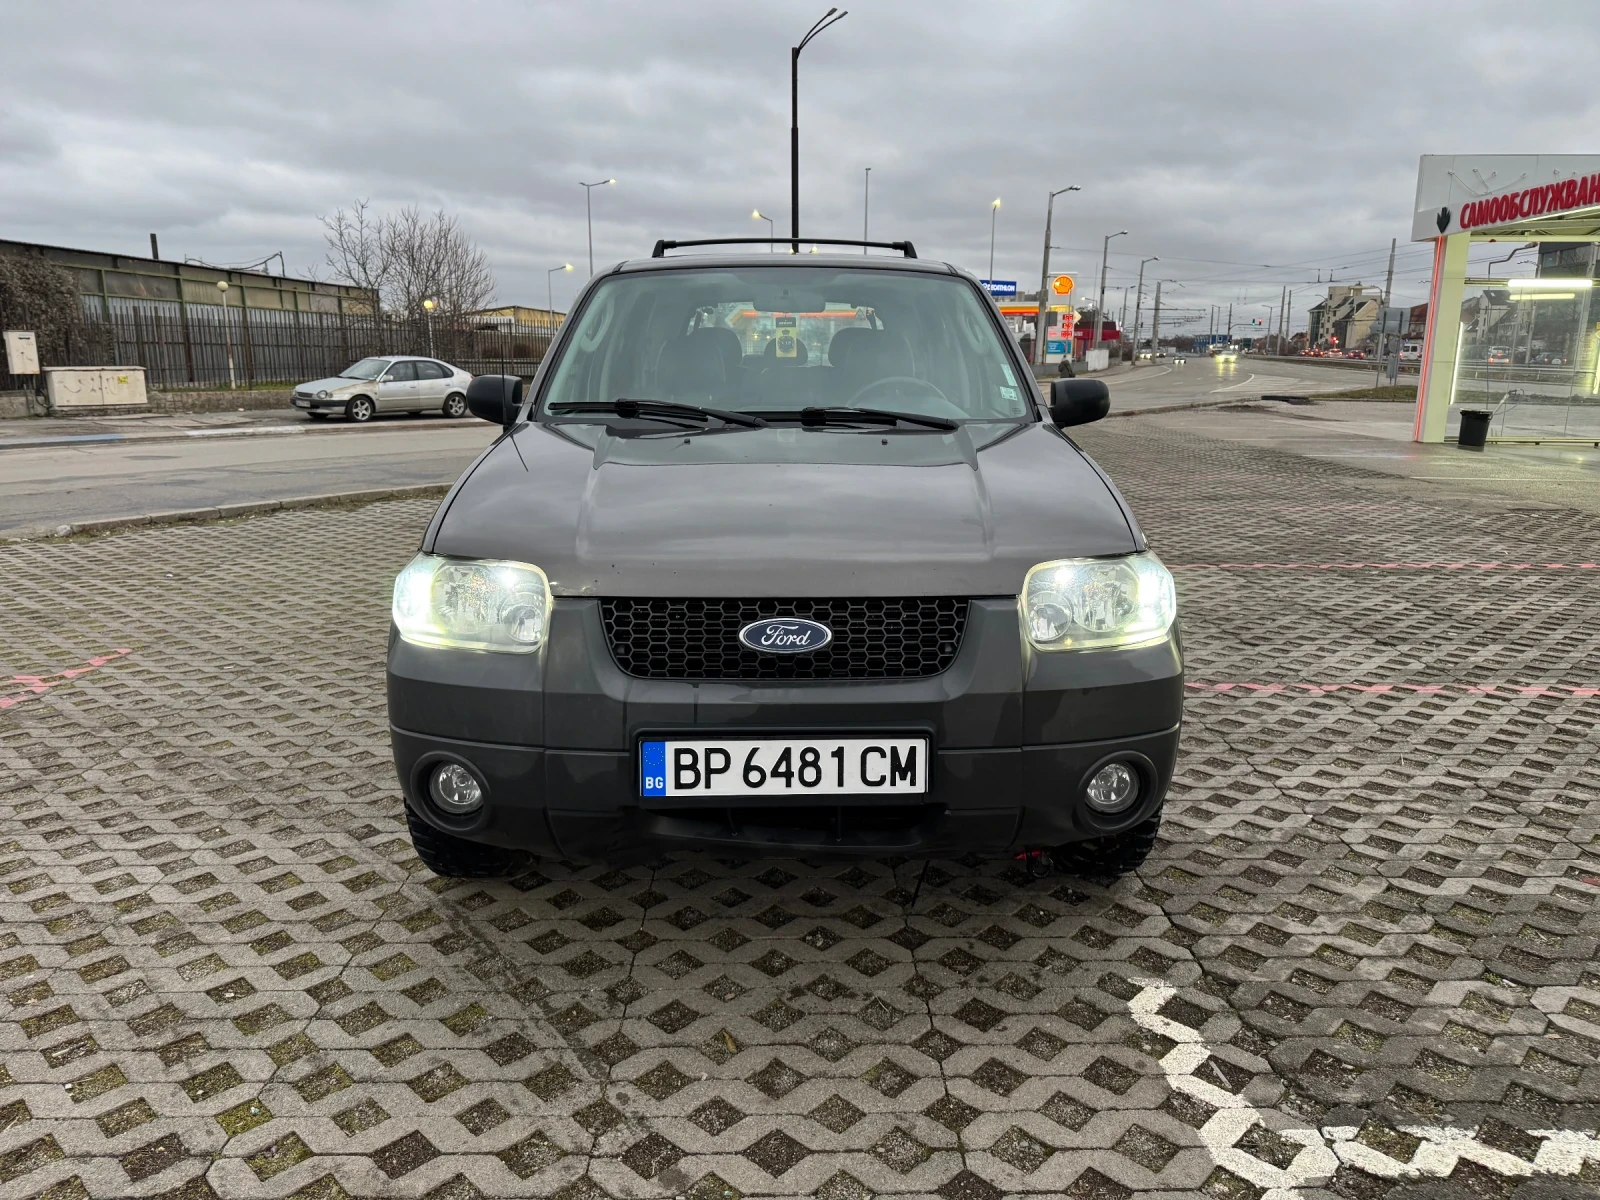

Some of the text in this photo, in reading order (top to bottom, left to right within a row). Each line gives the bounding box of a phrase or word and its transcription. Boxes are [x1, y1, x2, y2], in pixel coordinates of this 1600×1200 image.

[1460, 173, 1600, 229] САМООБСЛУЖВАН
[761, 624, 811, 645] Ford
[645, 776, 664, 789] BG
[674, 745, 917, 790] BP 6481 CM
